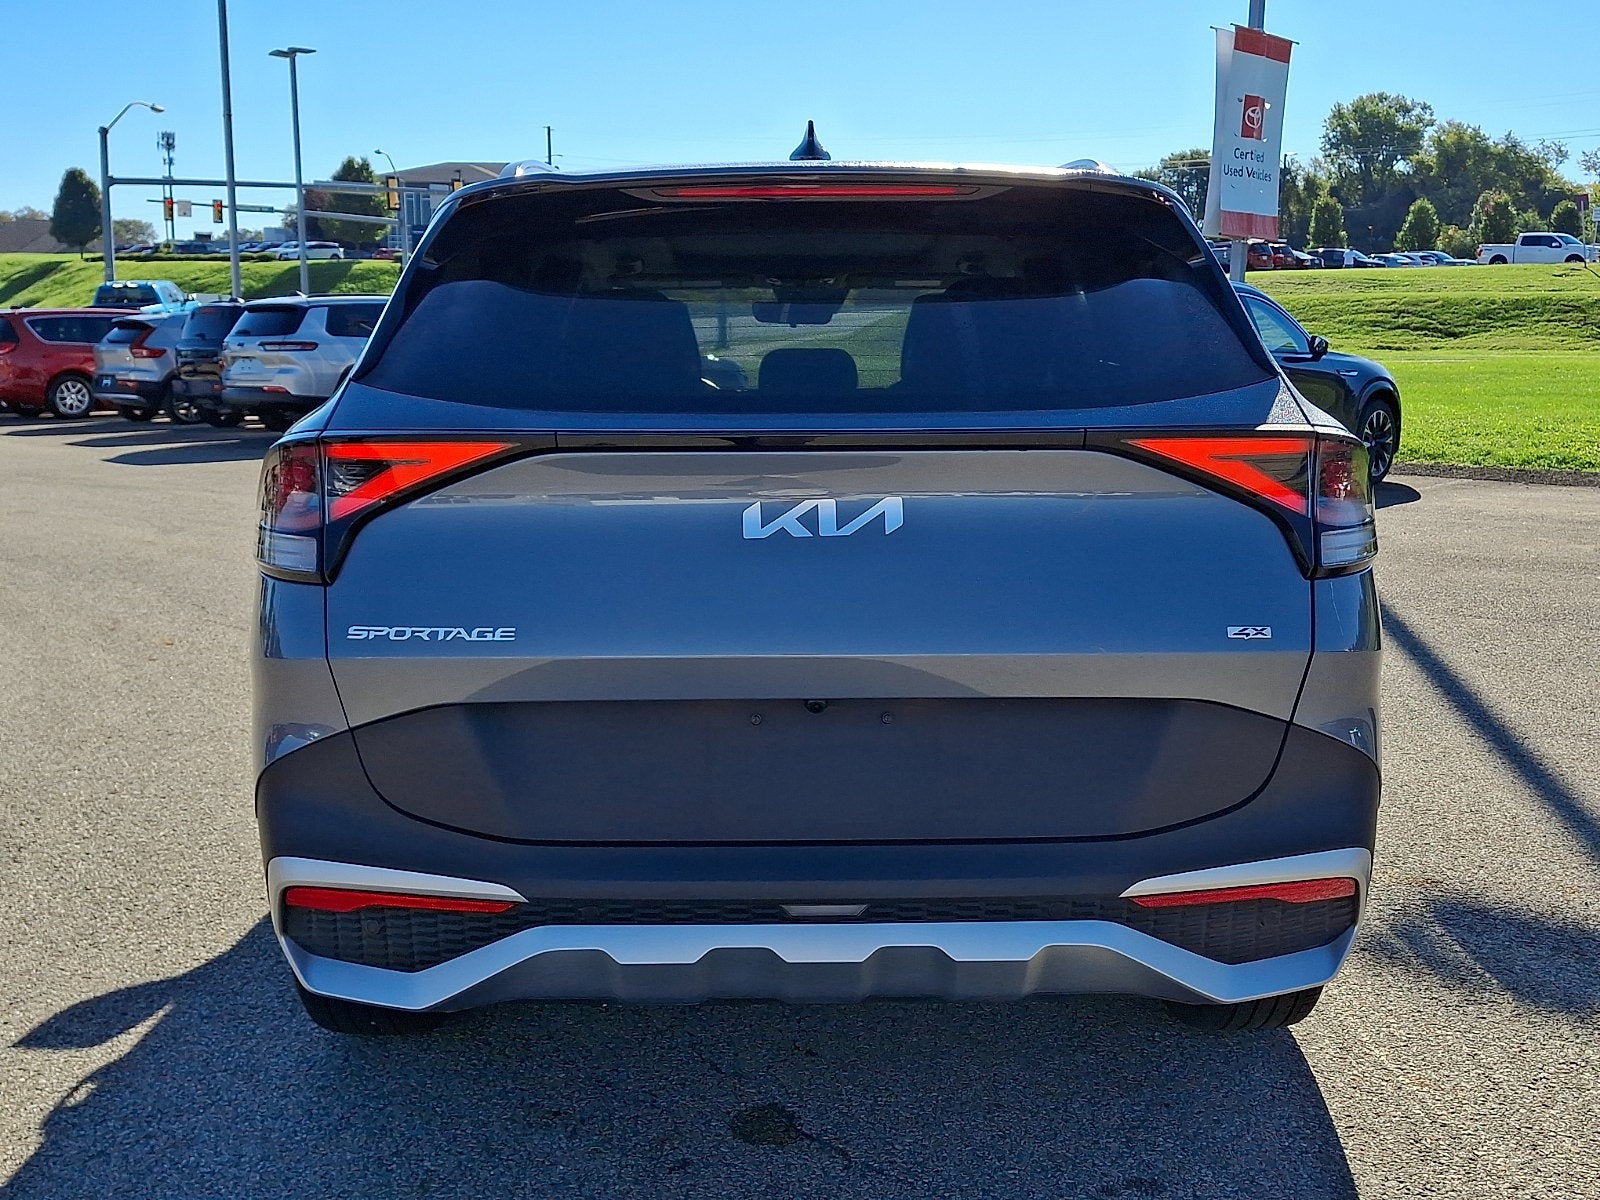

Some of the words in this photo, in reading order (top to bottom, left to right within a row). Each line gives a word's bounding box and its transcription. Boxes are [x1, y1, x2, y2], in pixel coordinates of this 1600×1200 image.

[1233, 147, 1265, 163] Certed
[1223, 163, 1244, 178] Used
[346, 625, 516, 642] SPORTAGE
